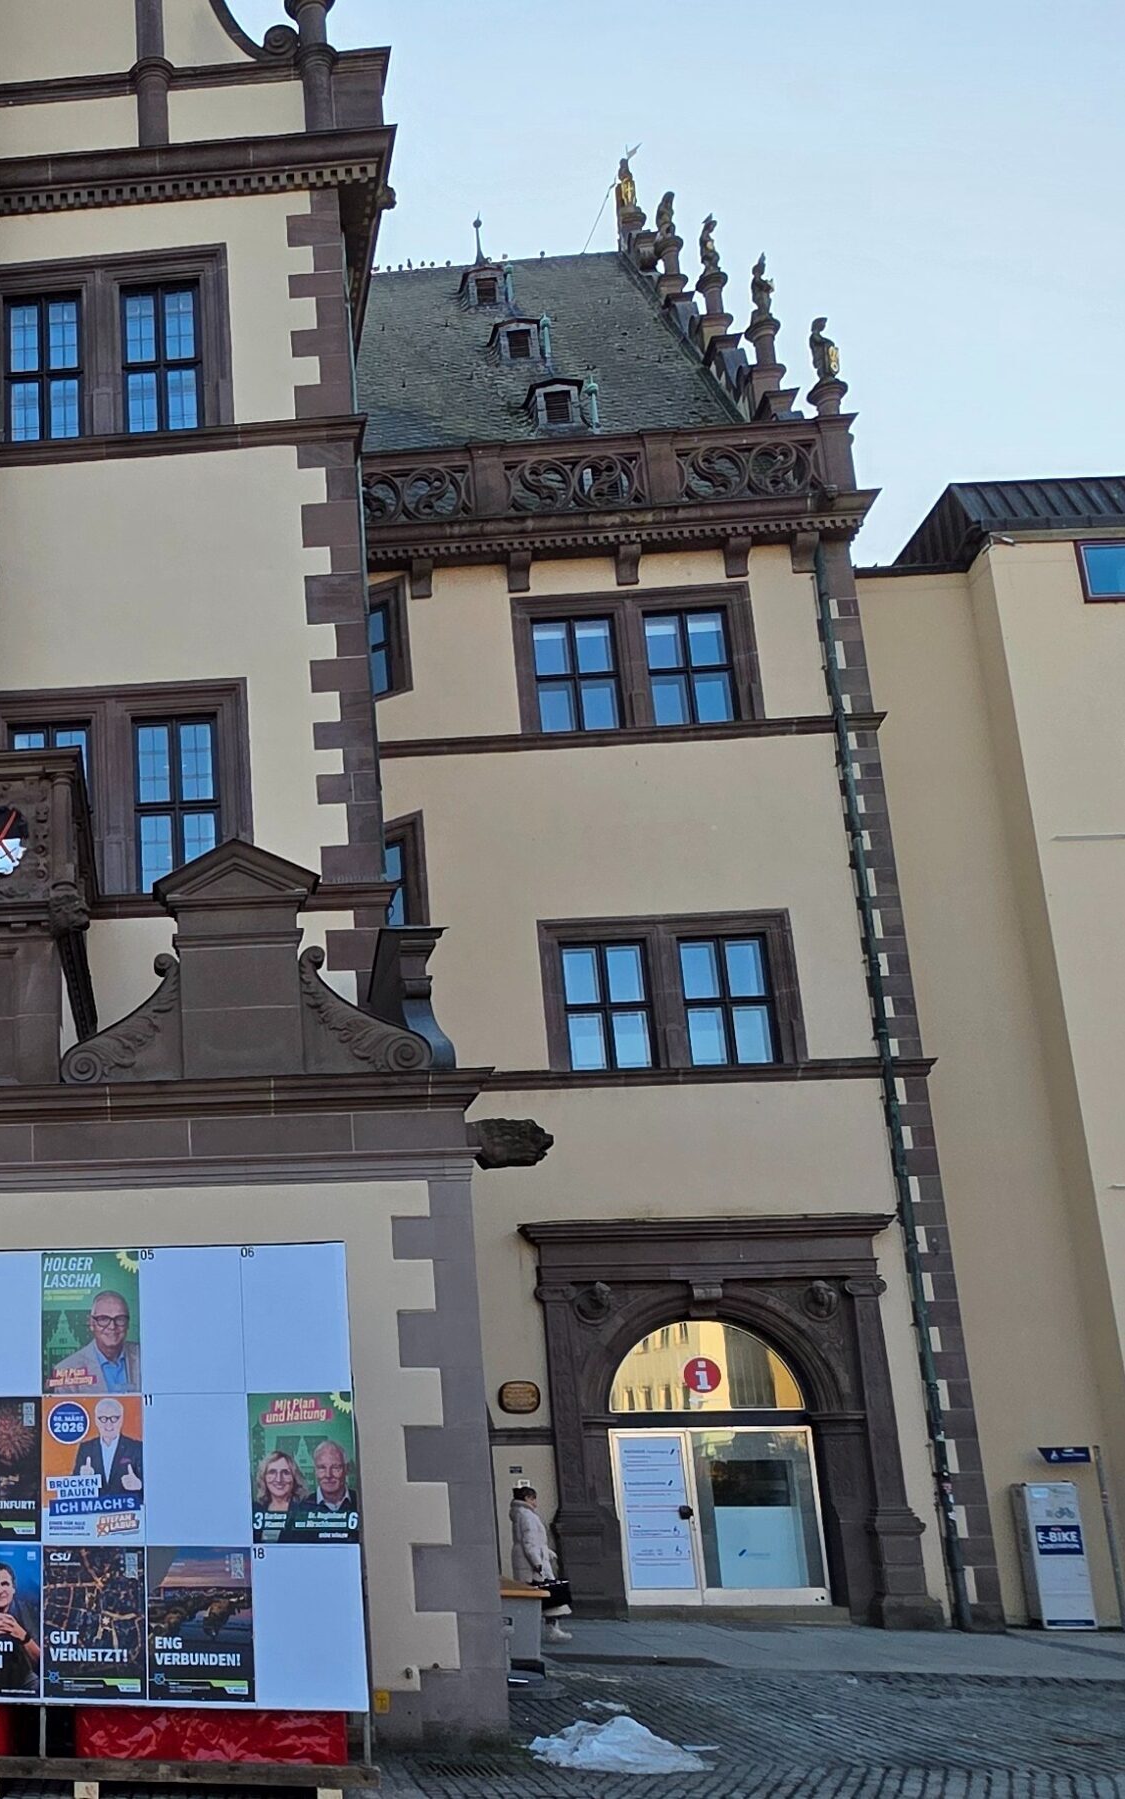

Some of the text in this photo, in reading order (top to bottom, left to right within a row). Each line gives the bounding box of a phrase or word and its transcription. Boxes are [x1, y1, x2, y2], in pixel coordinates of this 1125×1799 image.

[140, 1250, 154, 1260] 05
[240, 1247, 254, 1258] 06
[44, 1257, 93, 1272] HOLGER
[44, 1273, 101, 1288] LASCHKA
[144, 1394, 152, 1406] 11
[292, 1398, 316, 1410] Plan
[266, 1408, 326, 1423] und Haltung
[54, 1422, 84, 1432] 2026
[50, 1478, 98, 1488] BRÜCKEN
[60, 1488, 95, 1498] BAUEN
[55, 1498, 135, 1514] ICH MACH'S
[254, 1512, 264, 1530] 3
[348, 1512, 358, 1530] 6
[1037, 1532, 1078, 1542] E-BIKE
[50, 1552, 71, 1562] CSU
[253, 1548, 264, 1558] 18
[50, 1631, 80, 1644] GUT
[154, 1636, 182, 1649] ENG
[50, 1649, 128, 1662] VERNETZT!
[154, 1653, 240, 1666] VERBUNDEN!
